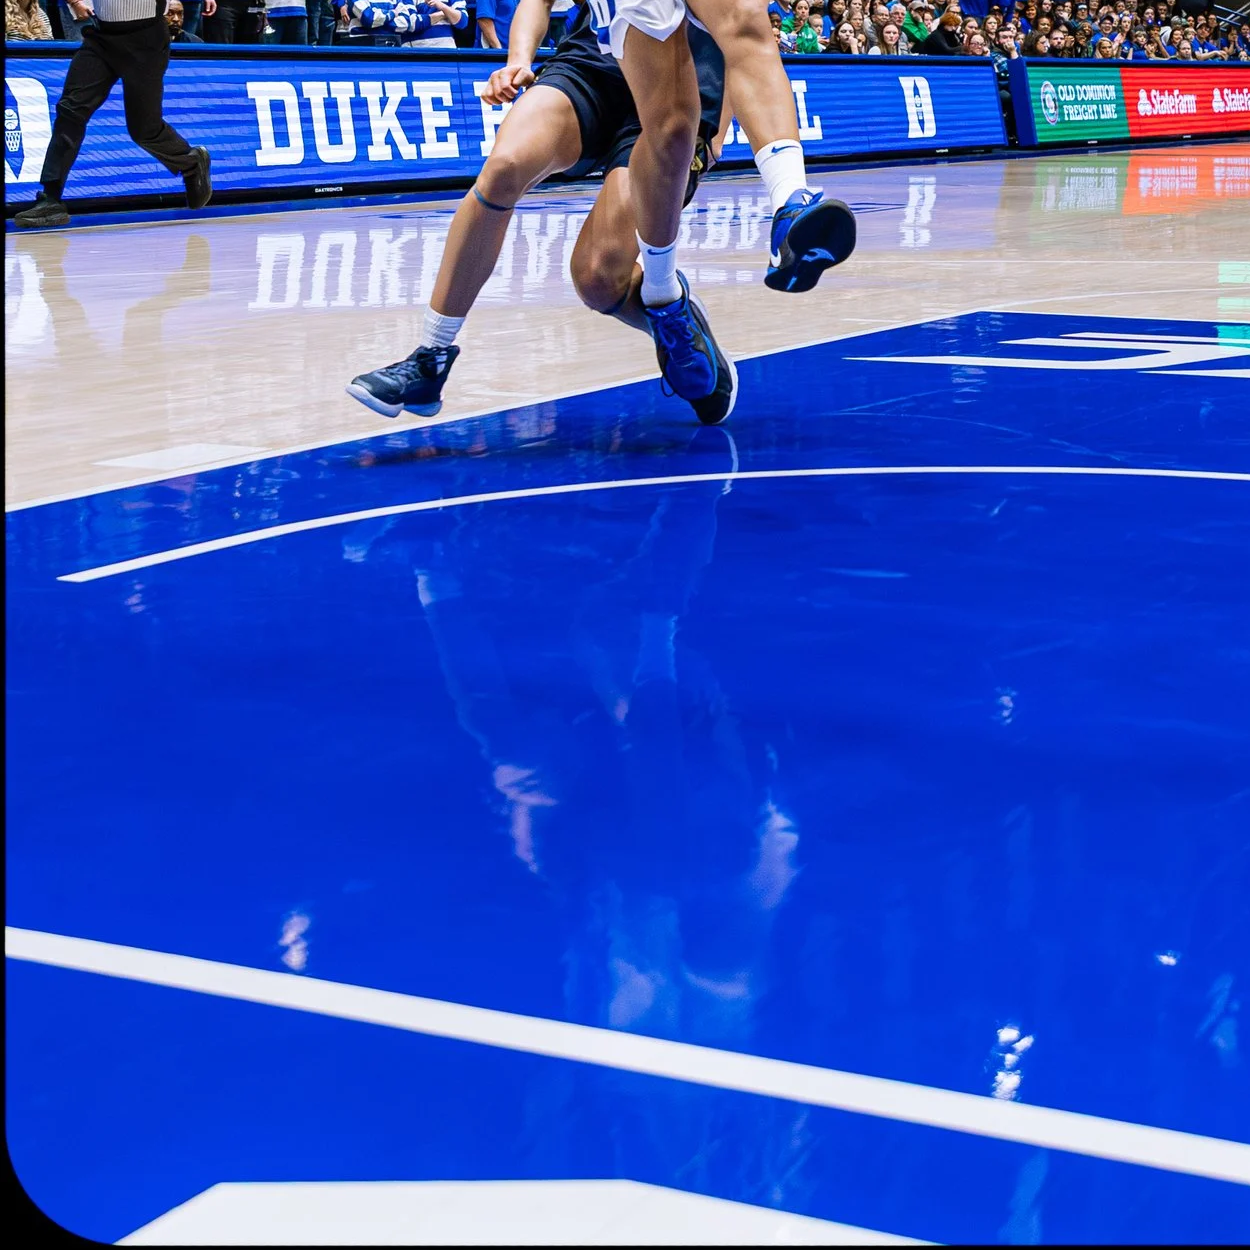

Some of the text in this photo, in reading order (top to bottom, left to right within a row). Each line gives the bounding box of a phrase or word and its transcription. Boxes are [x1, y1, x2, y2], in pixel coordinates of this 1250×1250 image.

[1058, 85, 1116, 101] OLD DOMINION
[1063, 104, 1118, 121] FREIGHT LINE
[246, 80, 460, 167] DUKE
